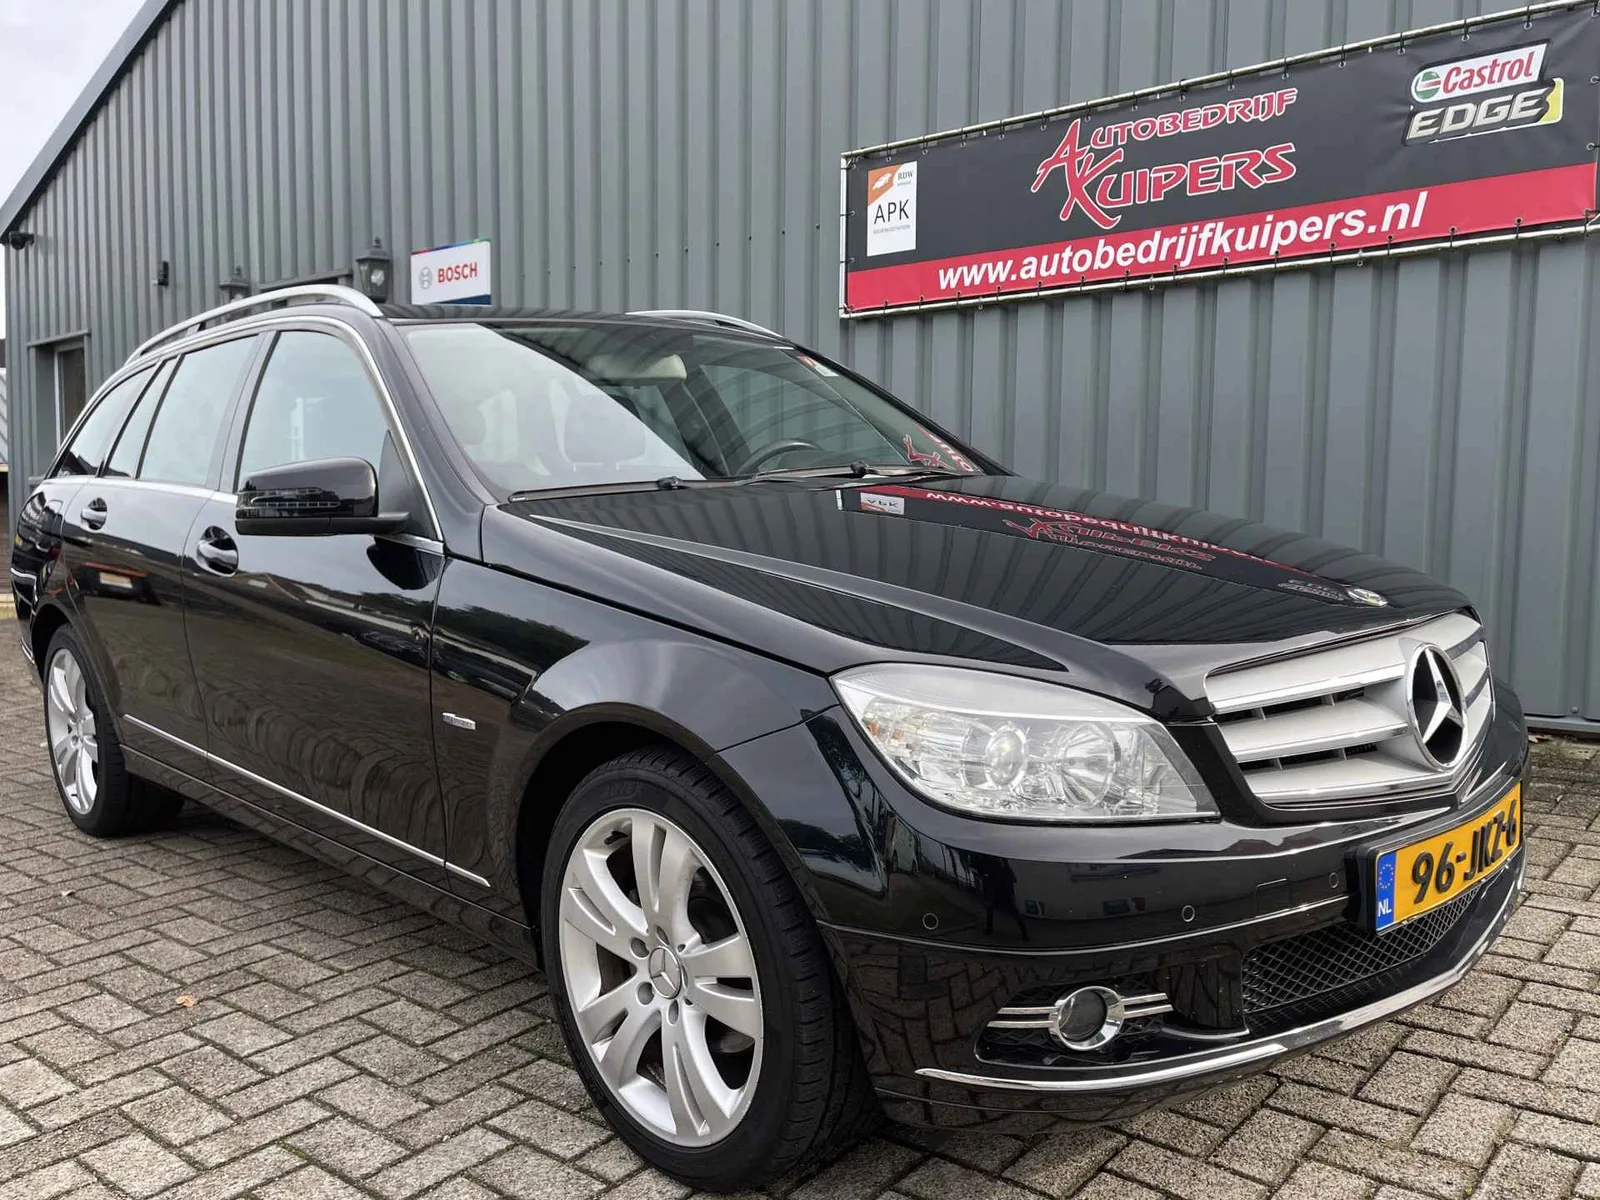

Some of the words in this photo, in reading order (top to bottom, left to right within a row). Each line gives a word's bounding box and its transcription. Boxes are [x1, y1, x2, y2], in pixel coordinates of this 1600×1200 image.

[1443, 51, 1535, 94] Castrol
[1406, 87, 1550, 141] EDGE
[1031, 87, 1298, 193] AUTOBEDRIJF
[897, 170, 913, 180] RDW
[1060, 142, 1297, 230] KUIPERS
[873, 199, 910, 225] APK
[938, 191, 1429, 291] www.autobedrijfkuipers.nl
[437, 261, 478, 283] BOSCH
[1411, 798, 1517, 905] 96-JKZ-6
[1377, 898, 1392, 917] NL
